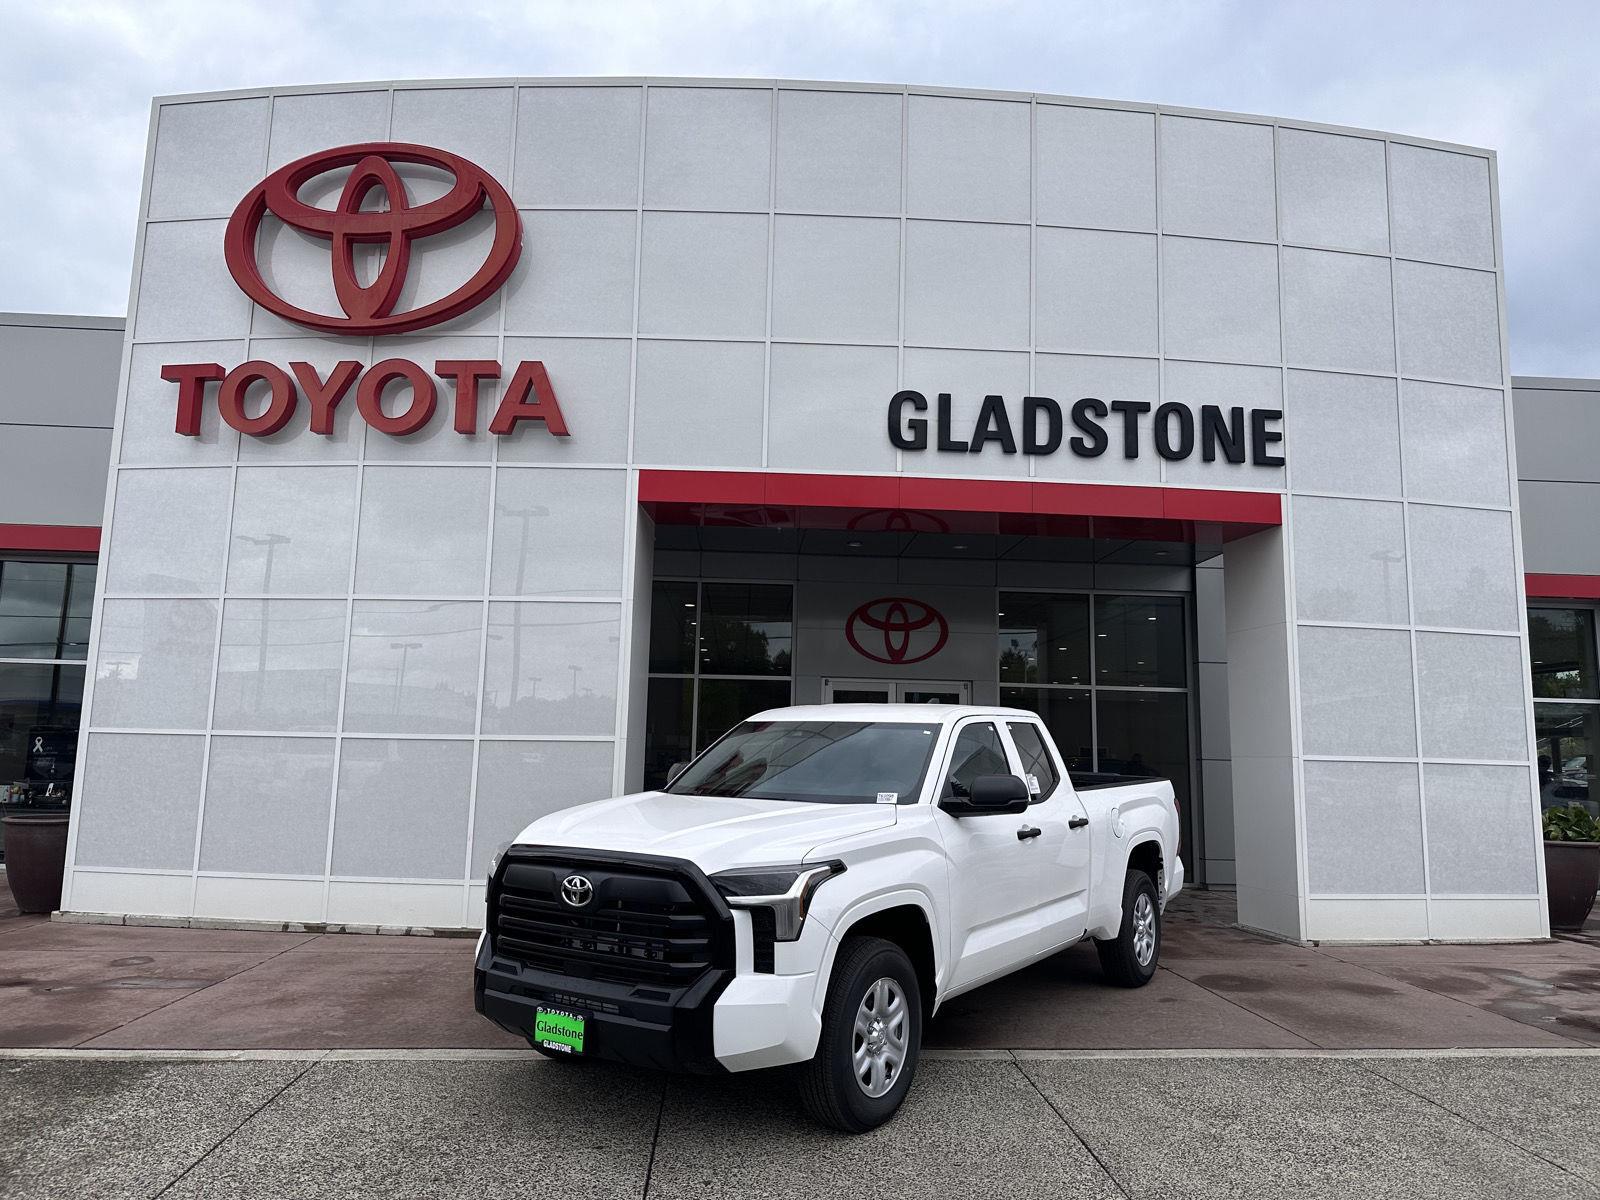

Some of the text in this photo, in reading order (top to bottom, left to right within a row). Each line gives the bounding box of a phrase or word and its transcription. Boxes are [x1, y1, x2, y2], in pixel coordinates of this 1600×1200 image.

[160, 358, 571, 437] TOYOTA
[888, 390, 1285, 466] GLADSTONE
[546, 1007, 573, 1019] TOYOTA
[536, 1020, 583, 1040] Gladstone
[543, 1040, 572, 1053] GLADSTONE
